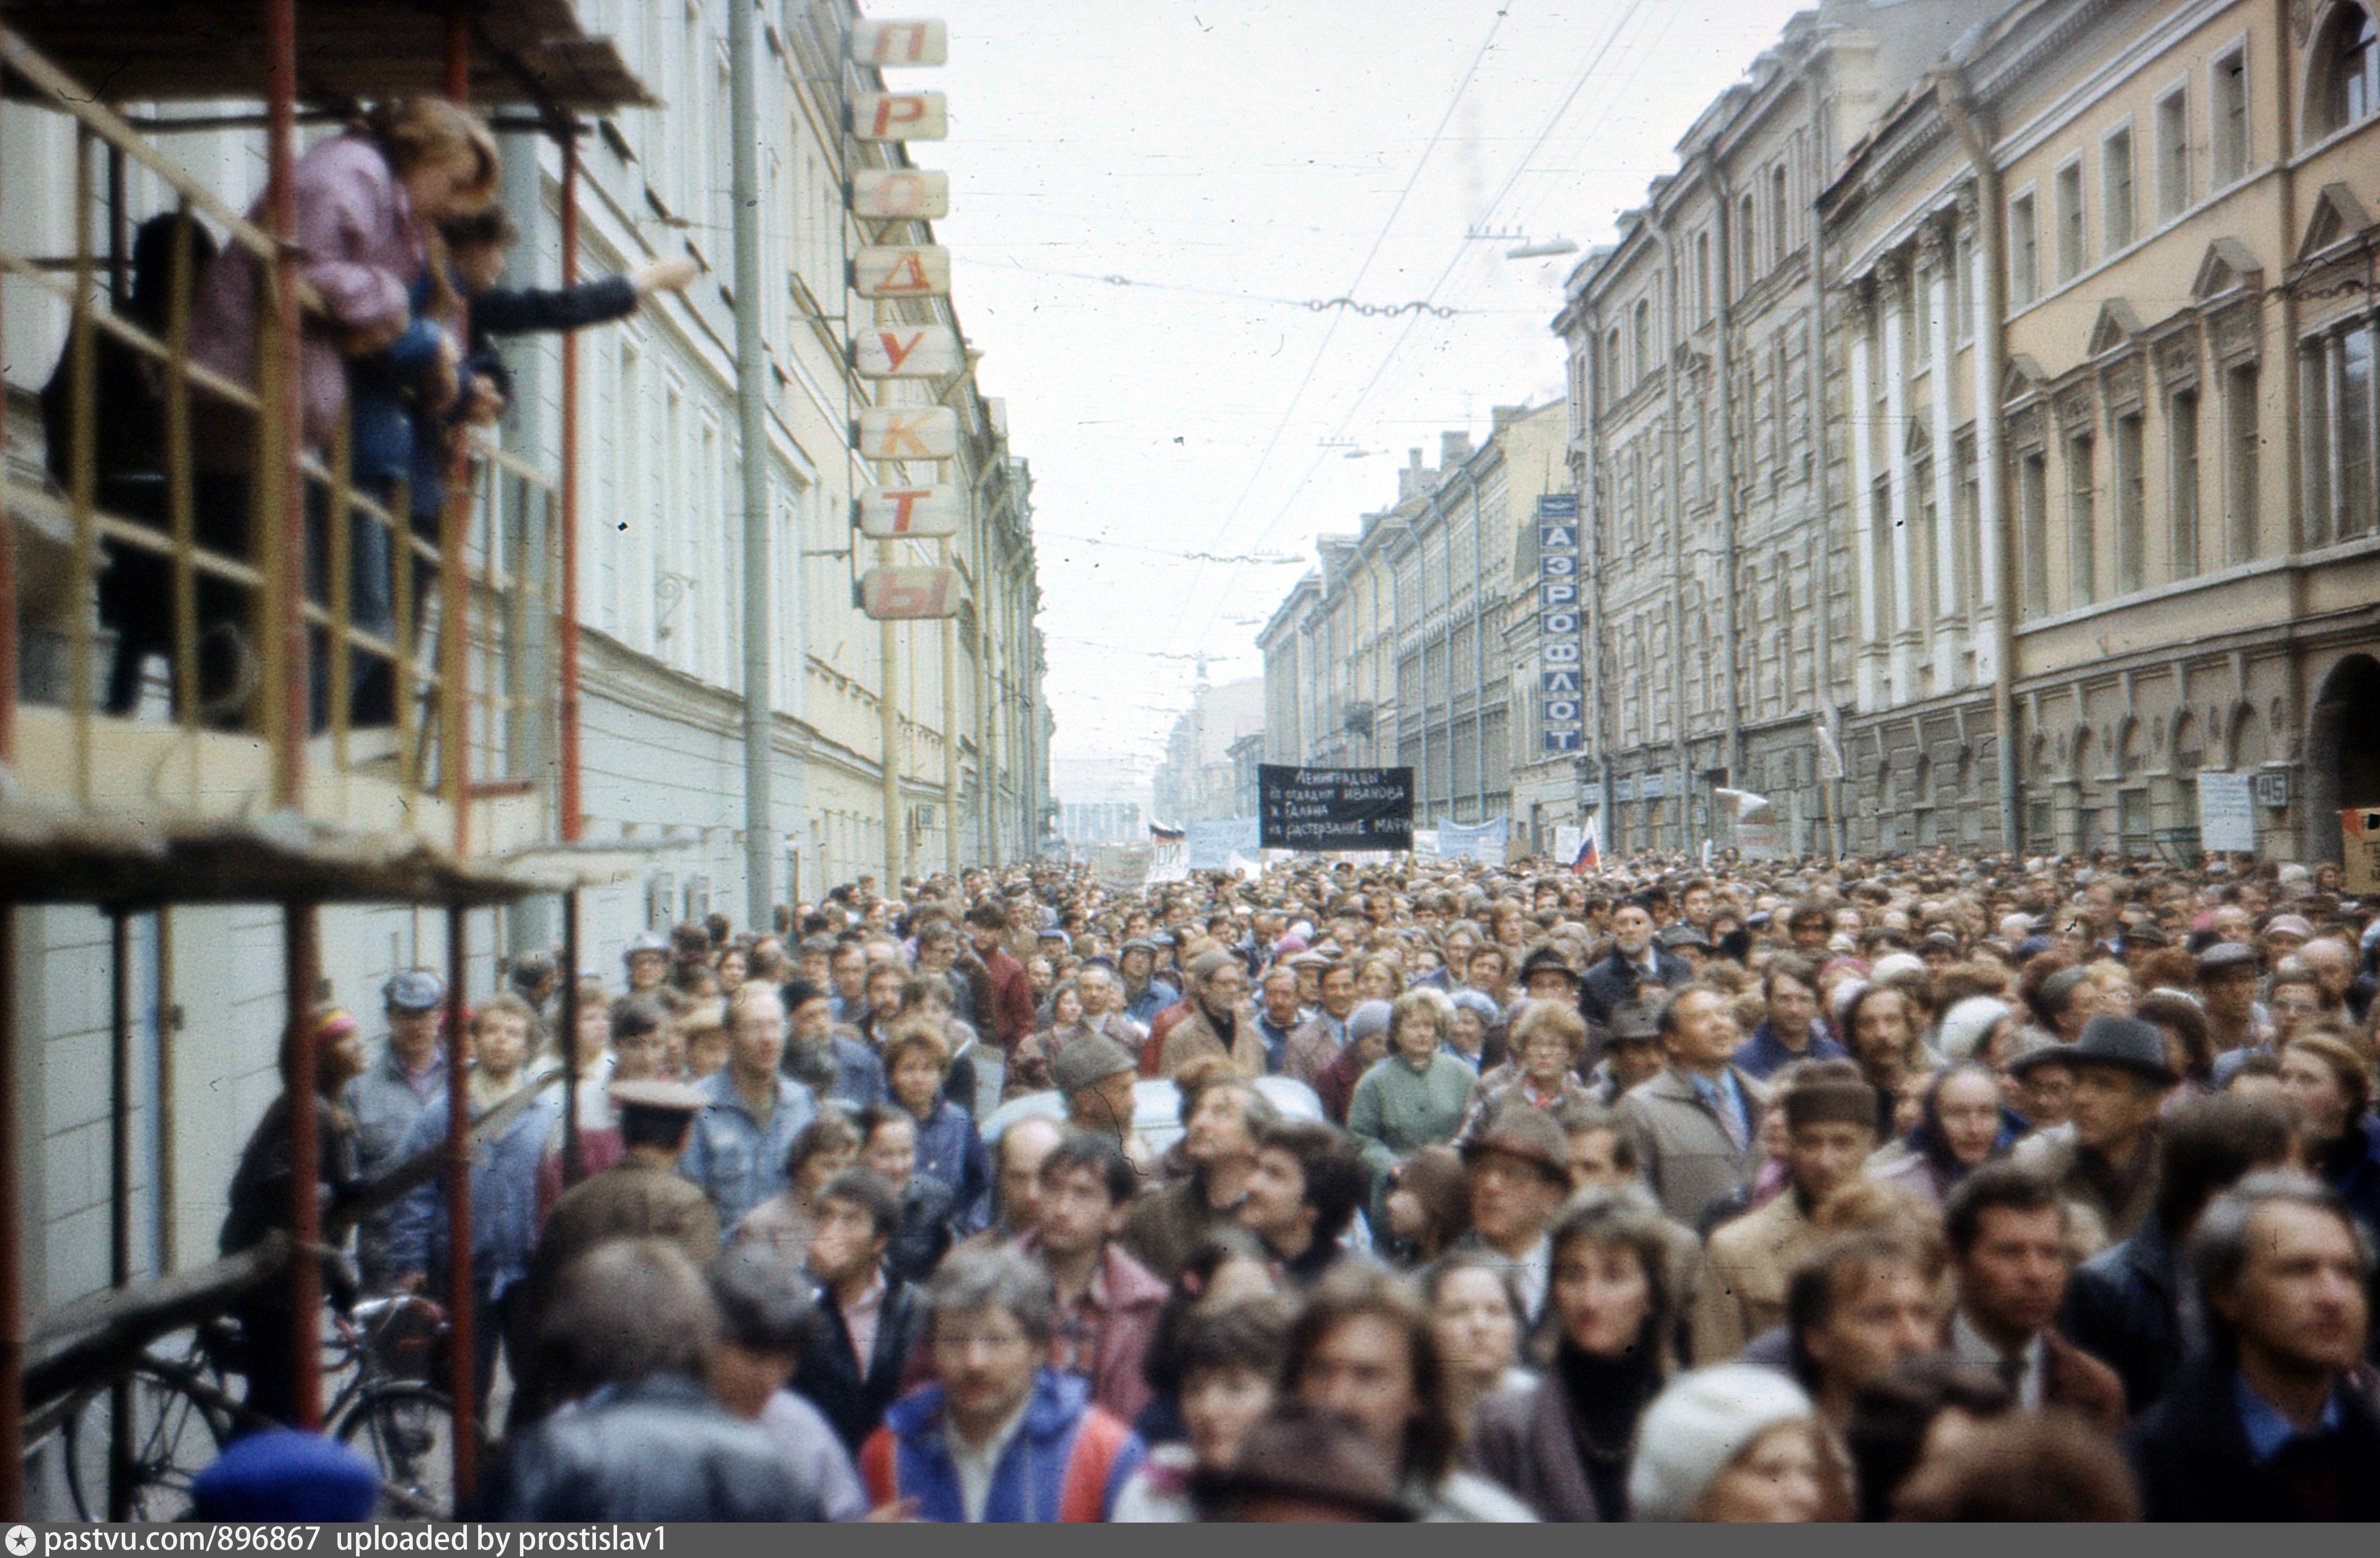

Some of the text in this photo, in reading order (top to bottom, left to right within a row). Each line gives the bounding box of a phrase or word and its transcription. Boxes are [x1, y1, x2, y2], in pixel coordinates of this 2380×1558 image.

[872, 22, 950, 614] ПРОДУКТЫ
[1545, 527, 1578, 749] АЭРОФЛОТ
[1344, 786, 1404, 800] ИВАНОВА
[2260, 777, 2283, 801] 45
[1285, 818, 1366, 841] РАСТЕРЗАНИЕ
